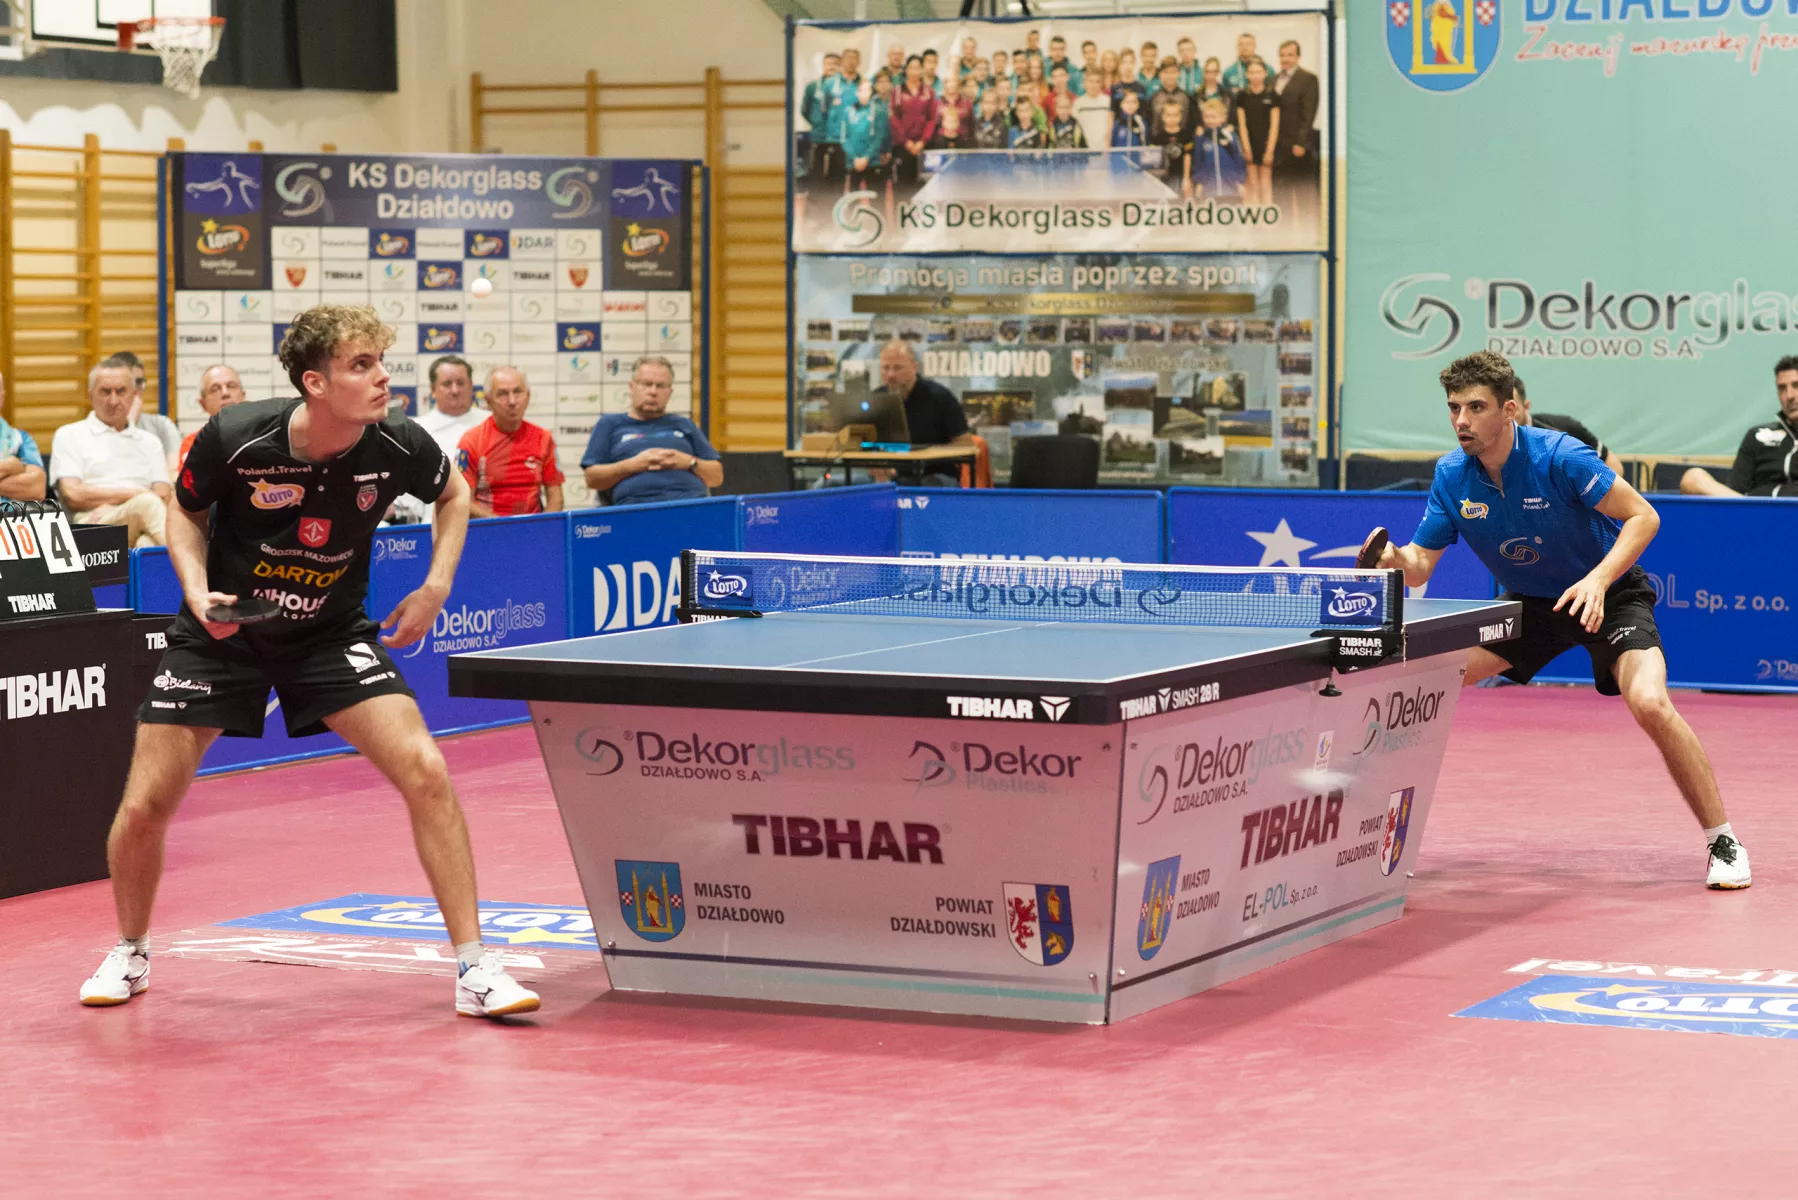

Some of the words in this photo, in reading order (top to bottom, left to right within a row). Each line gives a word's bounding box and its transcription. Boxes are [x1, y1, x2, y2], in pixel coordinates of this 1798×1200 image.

[348, 162, 388, 188] KS
[394, 163, 543, 195] Dekorglass
[377, 193, 514, 219] Działdowo
[900, 204, 936, 229] KS
[946, 202, 1112, 234] Dekorglass
[1122, 201, 1279, 227] Działdowo
[850, 262, 969, 289] Promocja
[979, 263, 1064, 286] miasta
[1072, 264, 1180, 290] poprzez
[1187, 262, 1258, 290] sport
[1487, 338, 1642, 358] DZIAŁDOWO
[1652, 338, 1701, 360] S.A.
[923, 349, 1051, 378] DZIAŁDOWO
[237, 465, 312, 475] Poland.Travel
[262, 489, 293, 504] LOTTO
[1466, 506, 1482, 515] LOTTO
[50, 522, 73, 567] 4
[261, 543, 303, 556] GRODZISK
[388, 538, 418, 552] Dekor
[713, 579, 739, 593] LOTTO
[7, 593, 57, 613] TIBHAR
[1337, 597, 1368, 613] LOTTO
[1695, 589, 1728, 614] Sp.
[1734, 595, 1747, 610] z
[1752, 595, 1790, 612] o.o.
[432, 598, 546, 638] Dekorglass
[145, 632, 168, 650] TIB
[433, 636, 482, 653] DZIAŁDOWO
[484, 635, 499, 647] S.A.
[1339, 636, 1382, 648] TIBHAR
[1479, 623, 1504, 643] TIBHAR
[1339, 647, 1373, 657] SMASH
[0, 665, 106, 720] TIBHAR
[169, 676, 212, 695] Bielany
[947, 696, 1034, 719] TIBHAR
[1120, 694, 1157, 720] TIBHAR
[1172, 686, 1199, 709] SMASH
[1200, 684, 1211, 703] 28
[1211, 682, 1220, 700] R
[1387, 686, 1445, 731] Dekor
[635, 730, 857, 776] Dekorglass
[963, 742, 1082, 778] Dekor
[1176, 726, 1305, 790] Dekorglass
[640, 765, 732, 781] DZIAŁDOWO
[736, 769, 766, 783] S.A.
[1173, 784, 1230, 814] DZIAŁDOWO
[1231, 780, 1249, 799] S.A.
[1240, 789, 1343, 870] TIBHAR
[1359, 815, 1384, 837] POWIAT
[731, 813, 945, 865] TIBHAR
[1336, 840, 1379, 868] DZIAŁDOWSKI
[694, 882, 753, 901] MIASTO
[1180, 868, 1211, 892] MIASTO
[935, 896, 994, 916] POWIAT
[1176, 891, 1221, 920] DZIAŁDOWO
[1242, 881, 1289, 922] EL-POL
[697, 904, 786, 925] DZIAŁDOWO
[890, 916, 997, 940] DZIAŁDOWSKI
